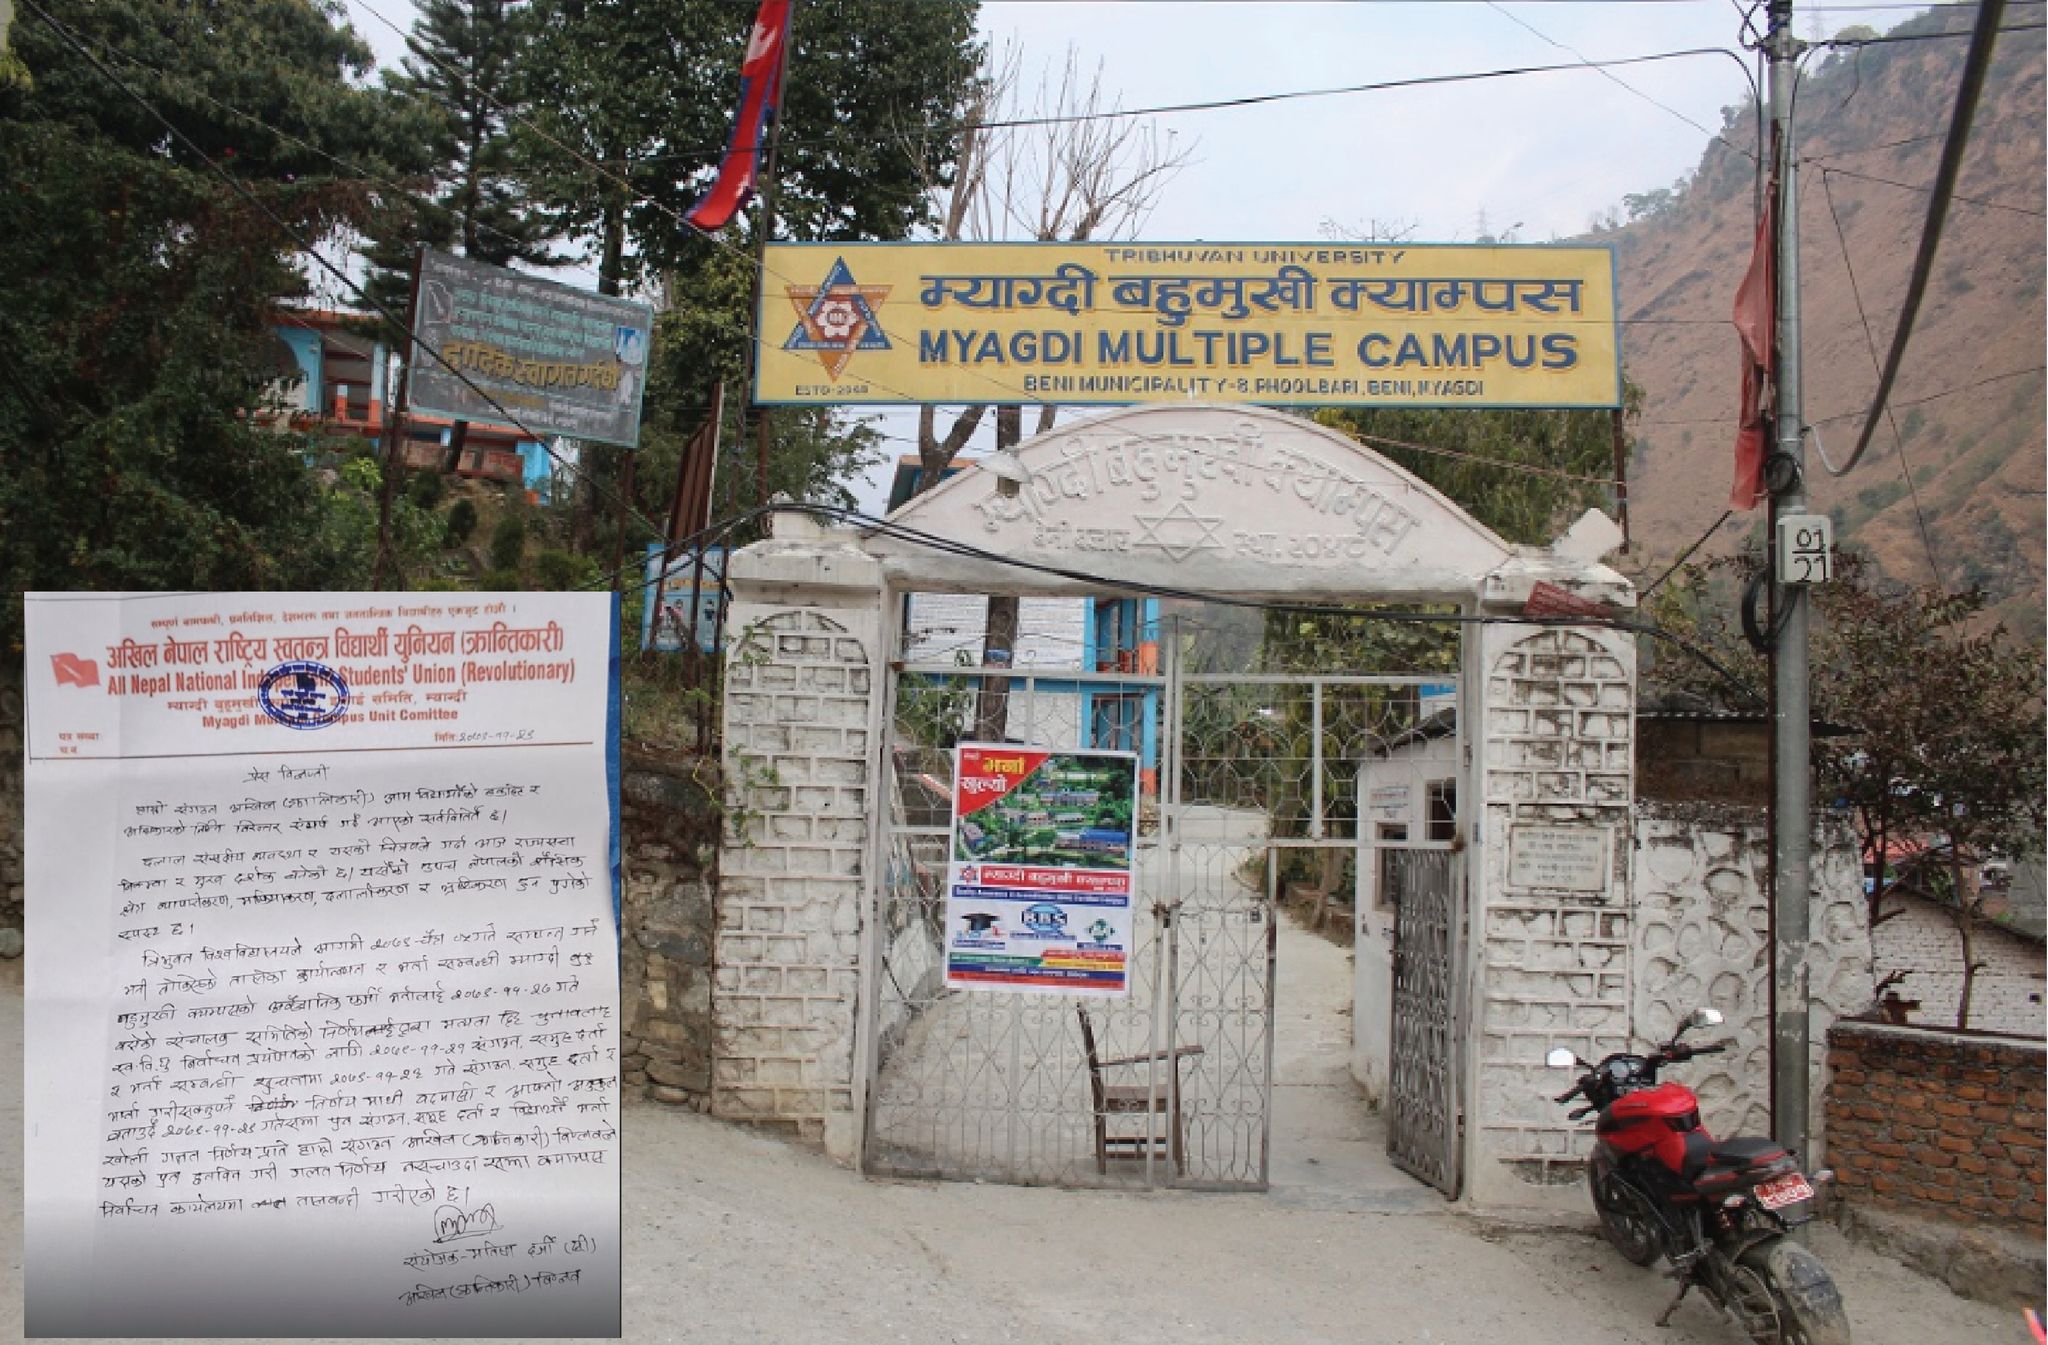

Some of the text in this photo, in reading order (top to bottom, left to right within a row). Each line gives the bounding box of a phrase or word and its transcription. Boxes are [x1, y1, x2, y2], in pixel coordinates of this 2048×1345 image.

[1104, 248, 1406, 264] TRIBHUVAN UNIVERSITY
[919, 262, 1585, 327] म्याग्दी बहुमुखी क्याम्पस
[919, 329, 1580, 370] MYAGDI MULTIPLE CAMPUS
[1024, 375, 1074, 392] BENI
[1796, 528, 1825, 550] 01
[106, 620, 563, 669] अखिल नेपाल राष्ट्रिय स्वतन्त्र विद्यार्थी युनियन (क्रान्तिकारी)
[107, 677, 126, 695] All
[131, 675, 171, 698] Nepal
[175, 671, 238, 692] National
[339, 665, 408, 686] Students'
[413, 664, 456, 684] Union
[461, 658, 575, 687] (Revolutionary)
[202, 714, 250, 730] Myagdi
[369, 710, 396, 722] Unit
[399, 709, 459, 722] Comittee
[229, 797, 276, 814] अखिल
[384, 789, 411, 804] आम
[308, 849, 318, 859] र
[175, 877, 185, 888] र
[418, 883, 431, 894] र
[376, 961, 388, 975] र
[606, 1047, 618, 1061] र
[484, 1085, 497, 1098] र
[489, 1108, 499, 1119] र
